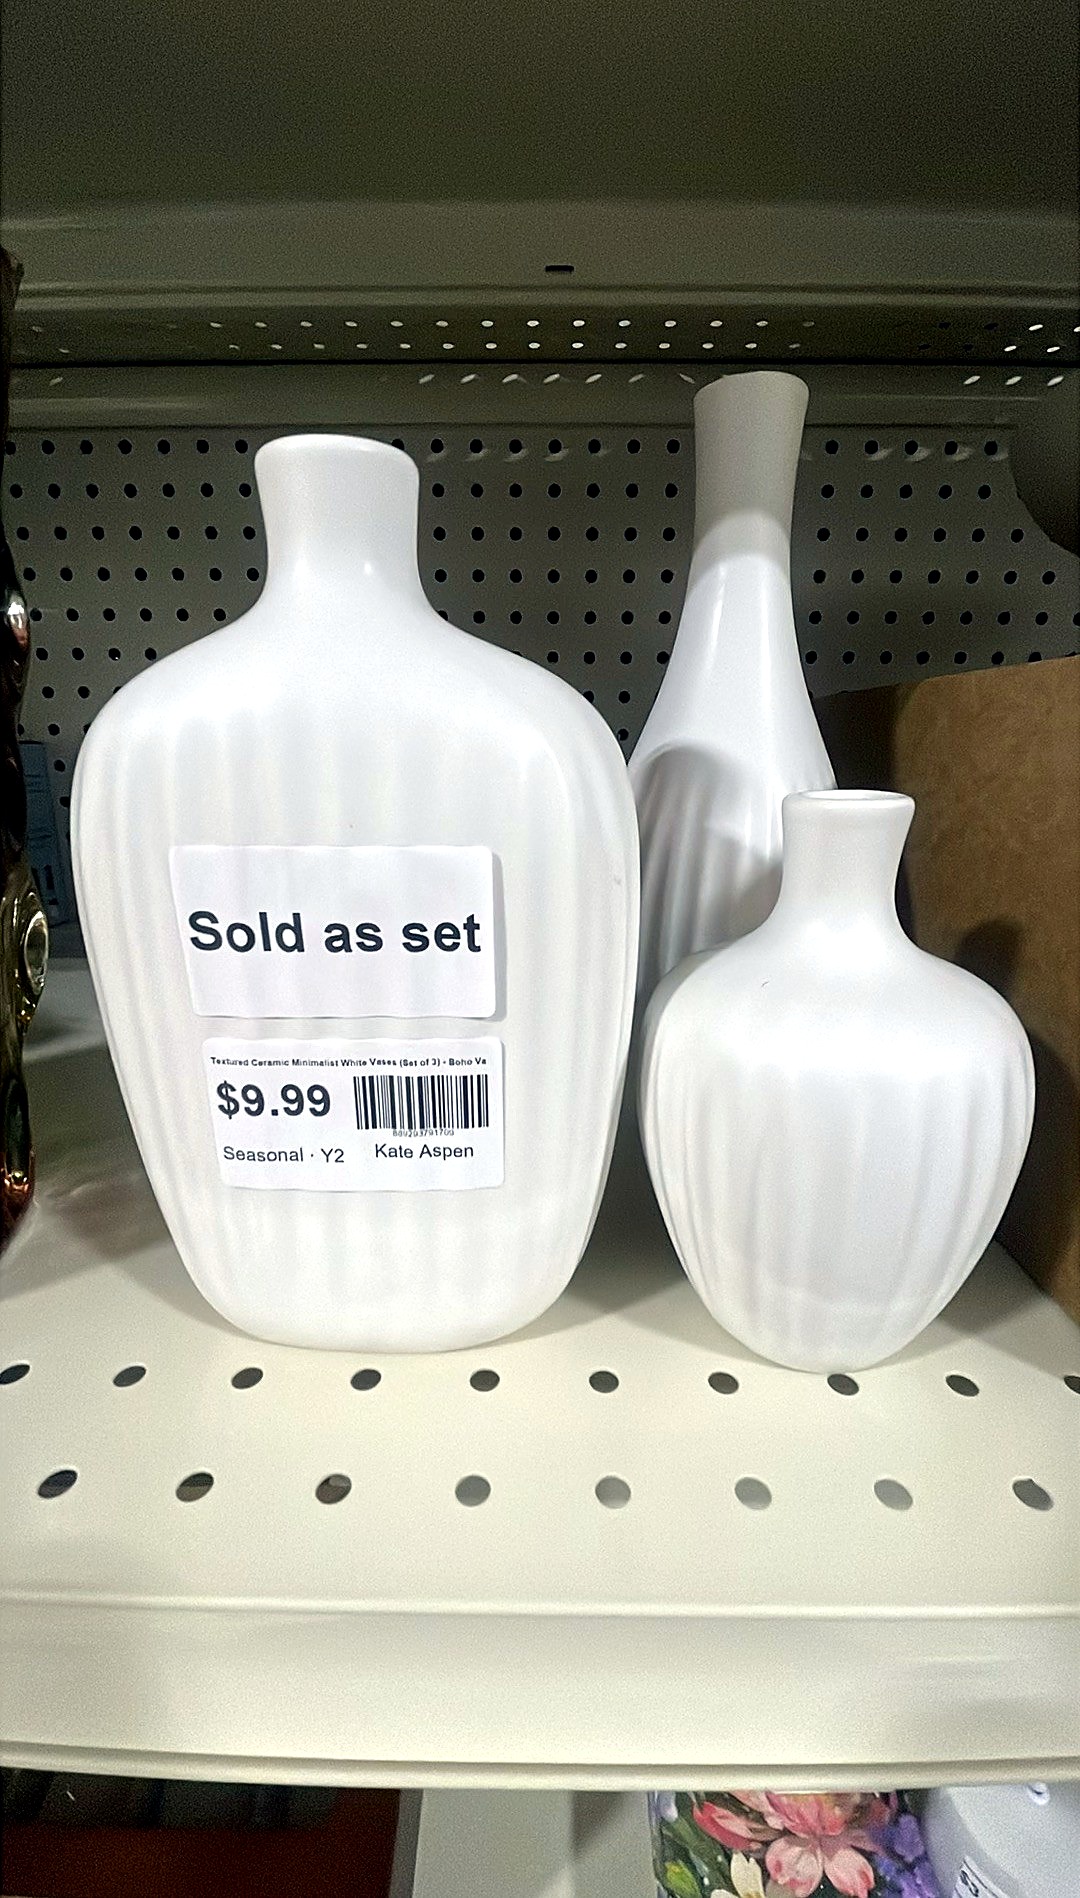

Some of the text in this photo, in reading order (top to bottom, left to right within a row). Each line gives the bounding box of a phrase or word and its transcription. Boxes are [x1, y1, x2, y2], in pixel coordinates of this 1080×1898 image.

[189, 911, 481, 953] Sold as set
[210, 1057, 249, 1067] Textured
[292, 1059, 338, 1067] Minimalist
[368, 1058, 397, 1066] Vases
[400, 1059, 417, 1067] (Set
[432, 1058, 440, 1067] 3)
[449, 1058, 472, 1066] Boho
[217, 1081, 330, 1119] $9.99
[224, 1146, 303, 1161] Seasonal
[321, 1149, 344, 1162] Y2
[376, 1144, 473, 1160] Kate Aspen
